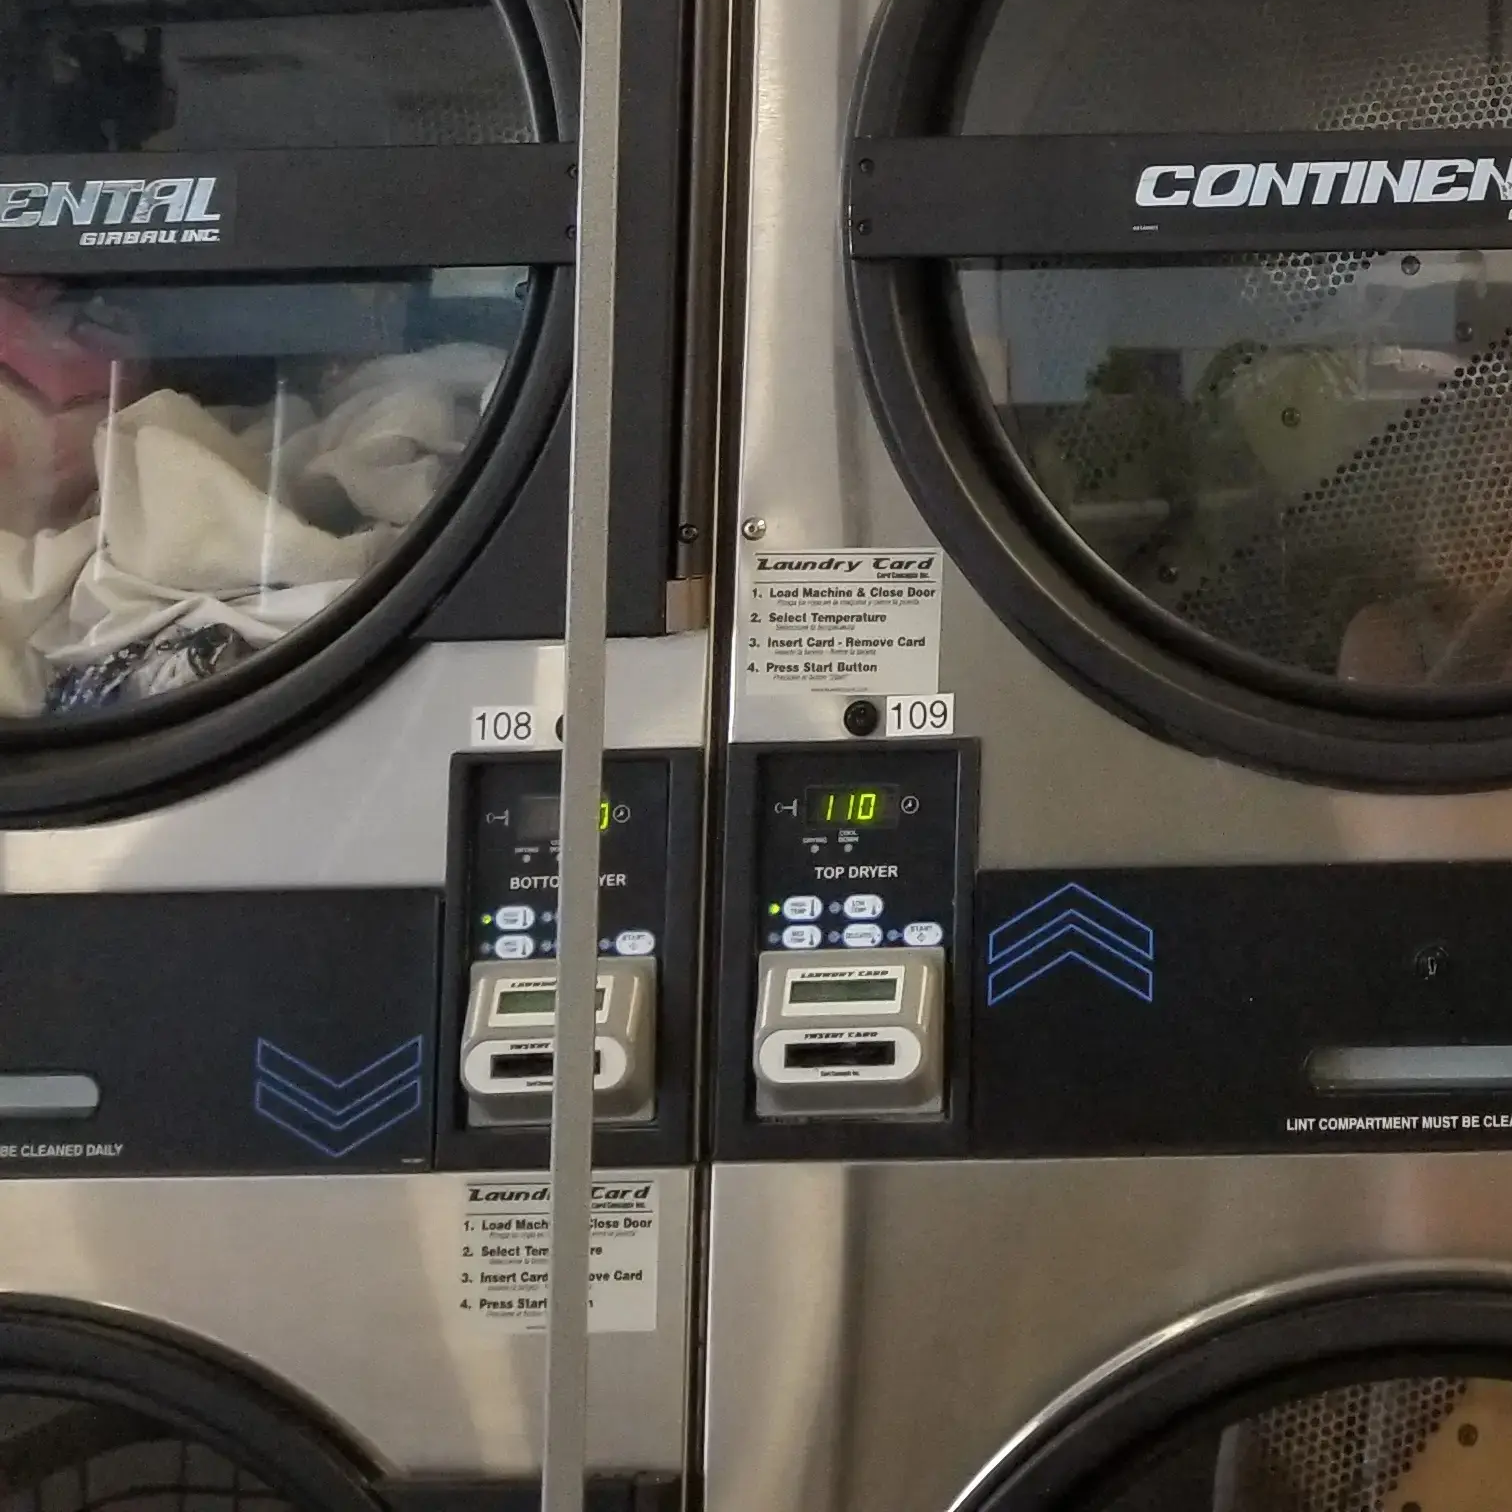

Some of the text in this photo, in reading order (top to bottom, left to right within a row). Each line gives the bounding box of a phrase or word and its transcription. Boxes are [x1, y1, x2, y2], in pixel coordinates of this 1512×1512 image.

[757, 557, 934, 572] Laundry Card
[770, 589, 798, 597] Load
[802, 588, 852, 597] Machine
[857, 588, 865, 597] &
[870, 588, 903, 597] Close
[907, 588, 935, 597] Door
[768, 613, 807, 623] Select
[812, 613, 886, 624] Temperature
[768, 638, 803, 647] Insert
[807, 638, 834, 647] Card
[846, 638, 893, 647] Remove
[897, 637, 925, 647] Card
[766, 663, 799, 672] Press
[804, 662, 832, 672] Start
[838, 663, 877, 672] Button
[892, 700, 948, 730] 109
[475, 712, 531, 741] 108
[826, 793, 876, 820] 110
[815, 865, 898, 879] TOP DRYER
[510, 874, 626, 889] BOTTO YER
[1287, 1118, 1315, 1131] LINT
[1319, 1117, 1419, 1130] COMPARTMENT
[1422, 1116, 1459, 1129] MUST
[1462, 1116, 1480, 1128] BE
[0, 1144, 124, 1157] BE CLEANED DAILY
[469, 1188, 551, 1202] Laund
[482, 1220, 511, 1230] Load
[516, 1219, 548, 1229] Mach
[624, 1217, 652, 1228] Door
[481, 1246, 520, 1256] Select
[480, 1272, 516, 1282] Insert
[614, 1270, 642, 1281] Card
[479, 1299, 512, 1309] Press
